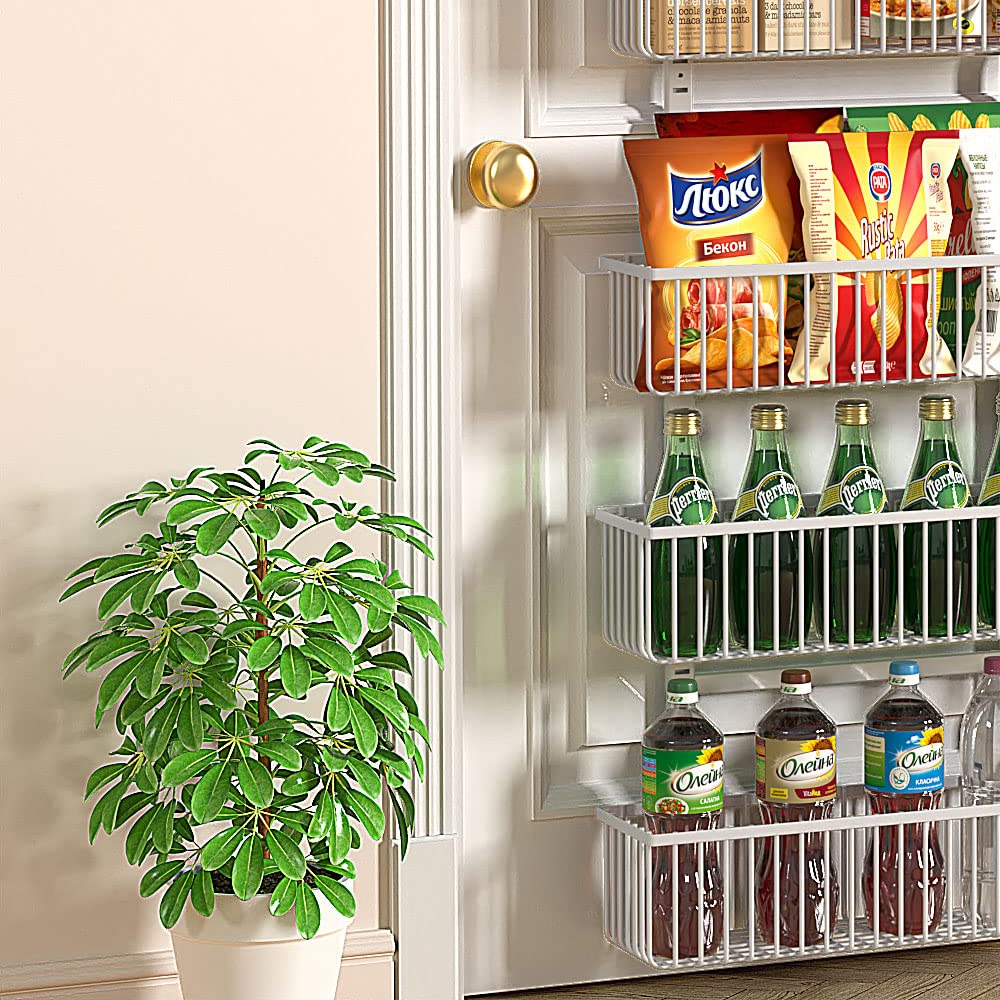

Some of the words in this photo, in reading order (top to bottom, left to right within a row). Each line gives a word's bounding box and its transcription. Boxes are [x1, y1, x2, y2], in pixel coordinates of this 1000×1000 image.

[668, 6, 710, 15] cocolae
[668, 16, 674, 24] &
[678, 16, 726, 24] macaamia
[674, 174, 760, 218] Люкс
[873, 176, 888, 188] PATA
[704, 240, 747, 256] Бекон
[860, 208, 894, 258] Rustic
[758, 476, 798, 509] Perrier
[843, 468, 883, 503] Perrier
[926, 465, 965, 499] Perrier
[672, 484, 713, 515] Perrier
[780, 754, 834, 778] Олейна
